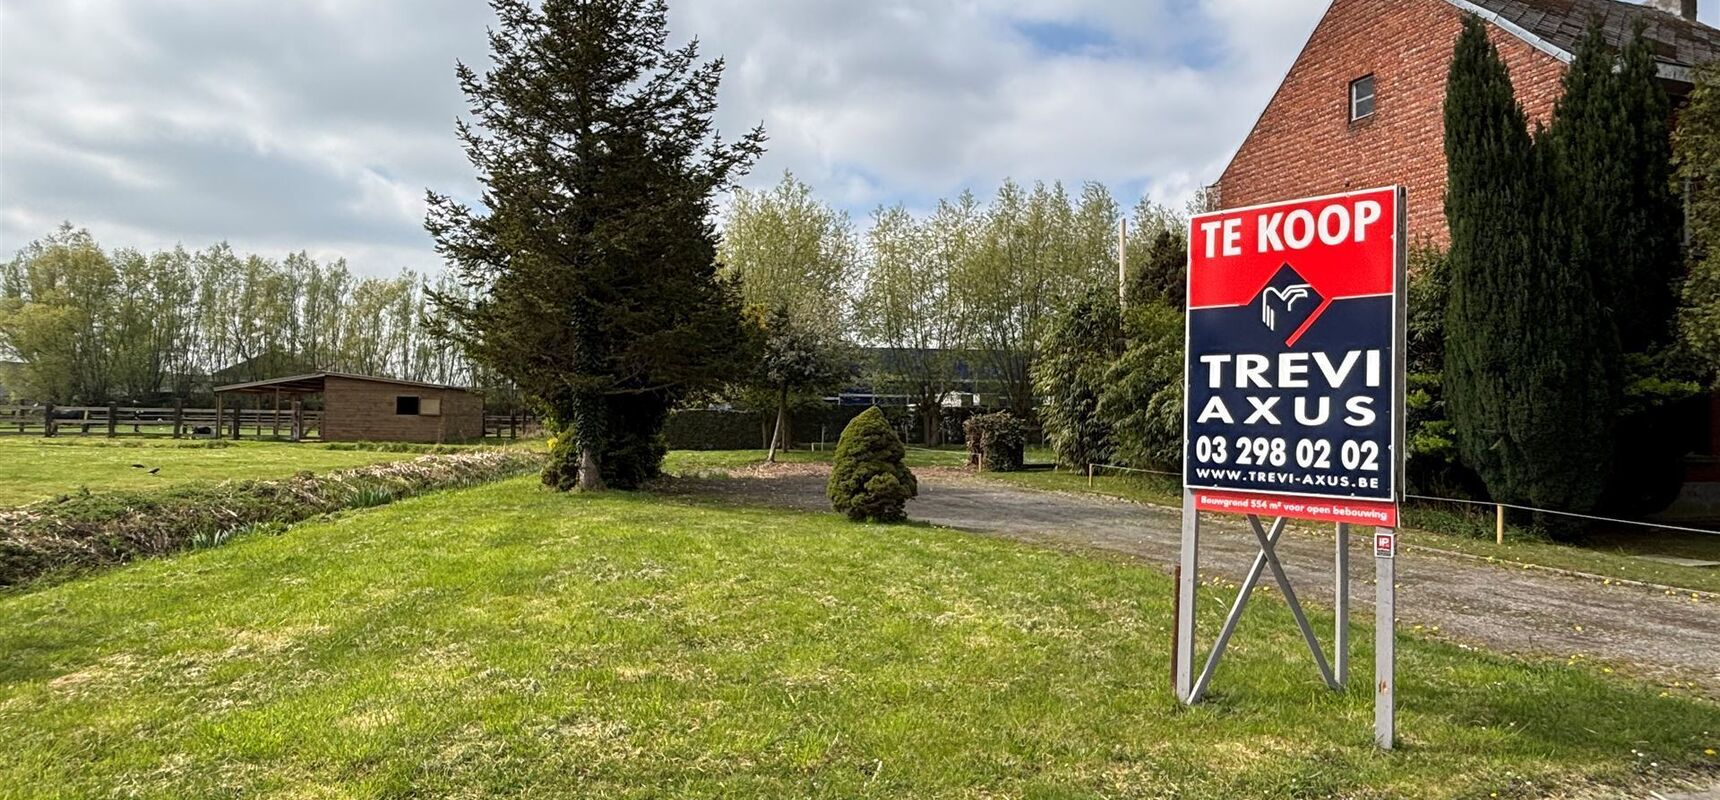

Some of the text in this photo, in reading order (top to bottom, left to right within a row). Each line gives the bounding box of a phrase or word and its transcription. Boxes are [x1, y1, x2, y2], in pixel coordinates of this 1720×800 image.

[1201, 200, 1382, 258] TE KOOP
[1200, 350, 1380, 388] TREVI
[1196, 395, 1377, 426] AXUS
[1195, 435, 1379, 471] 03 298 02 02
[1196, 468, 1379, 489] WWW.TREVI-AXUS.BE
[1201, 495, 1247, 508] Bouwgrond
[1250, 497, 1268, 509] 554
[1283, 503, 1305, 512] voor
[1306, 504, 1331, 516] open
[1332, 503, 1388, 521] bebouwing
